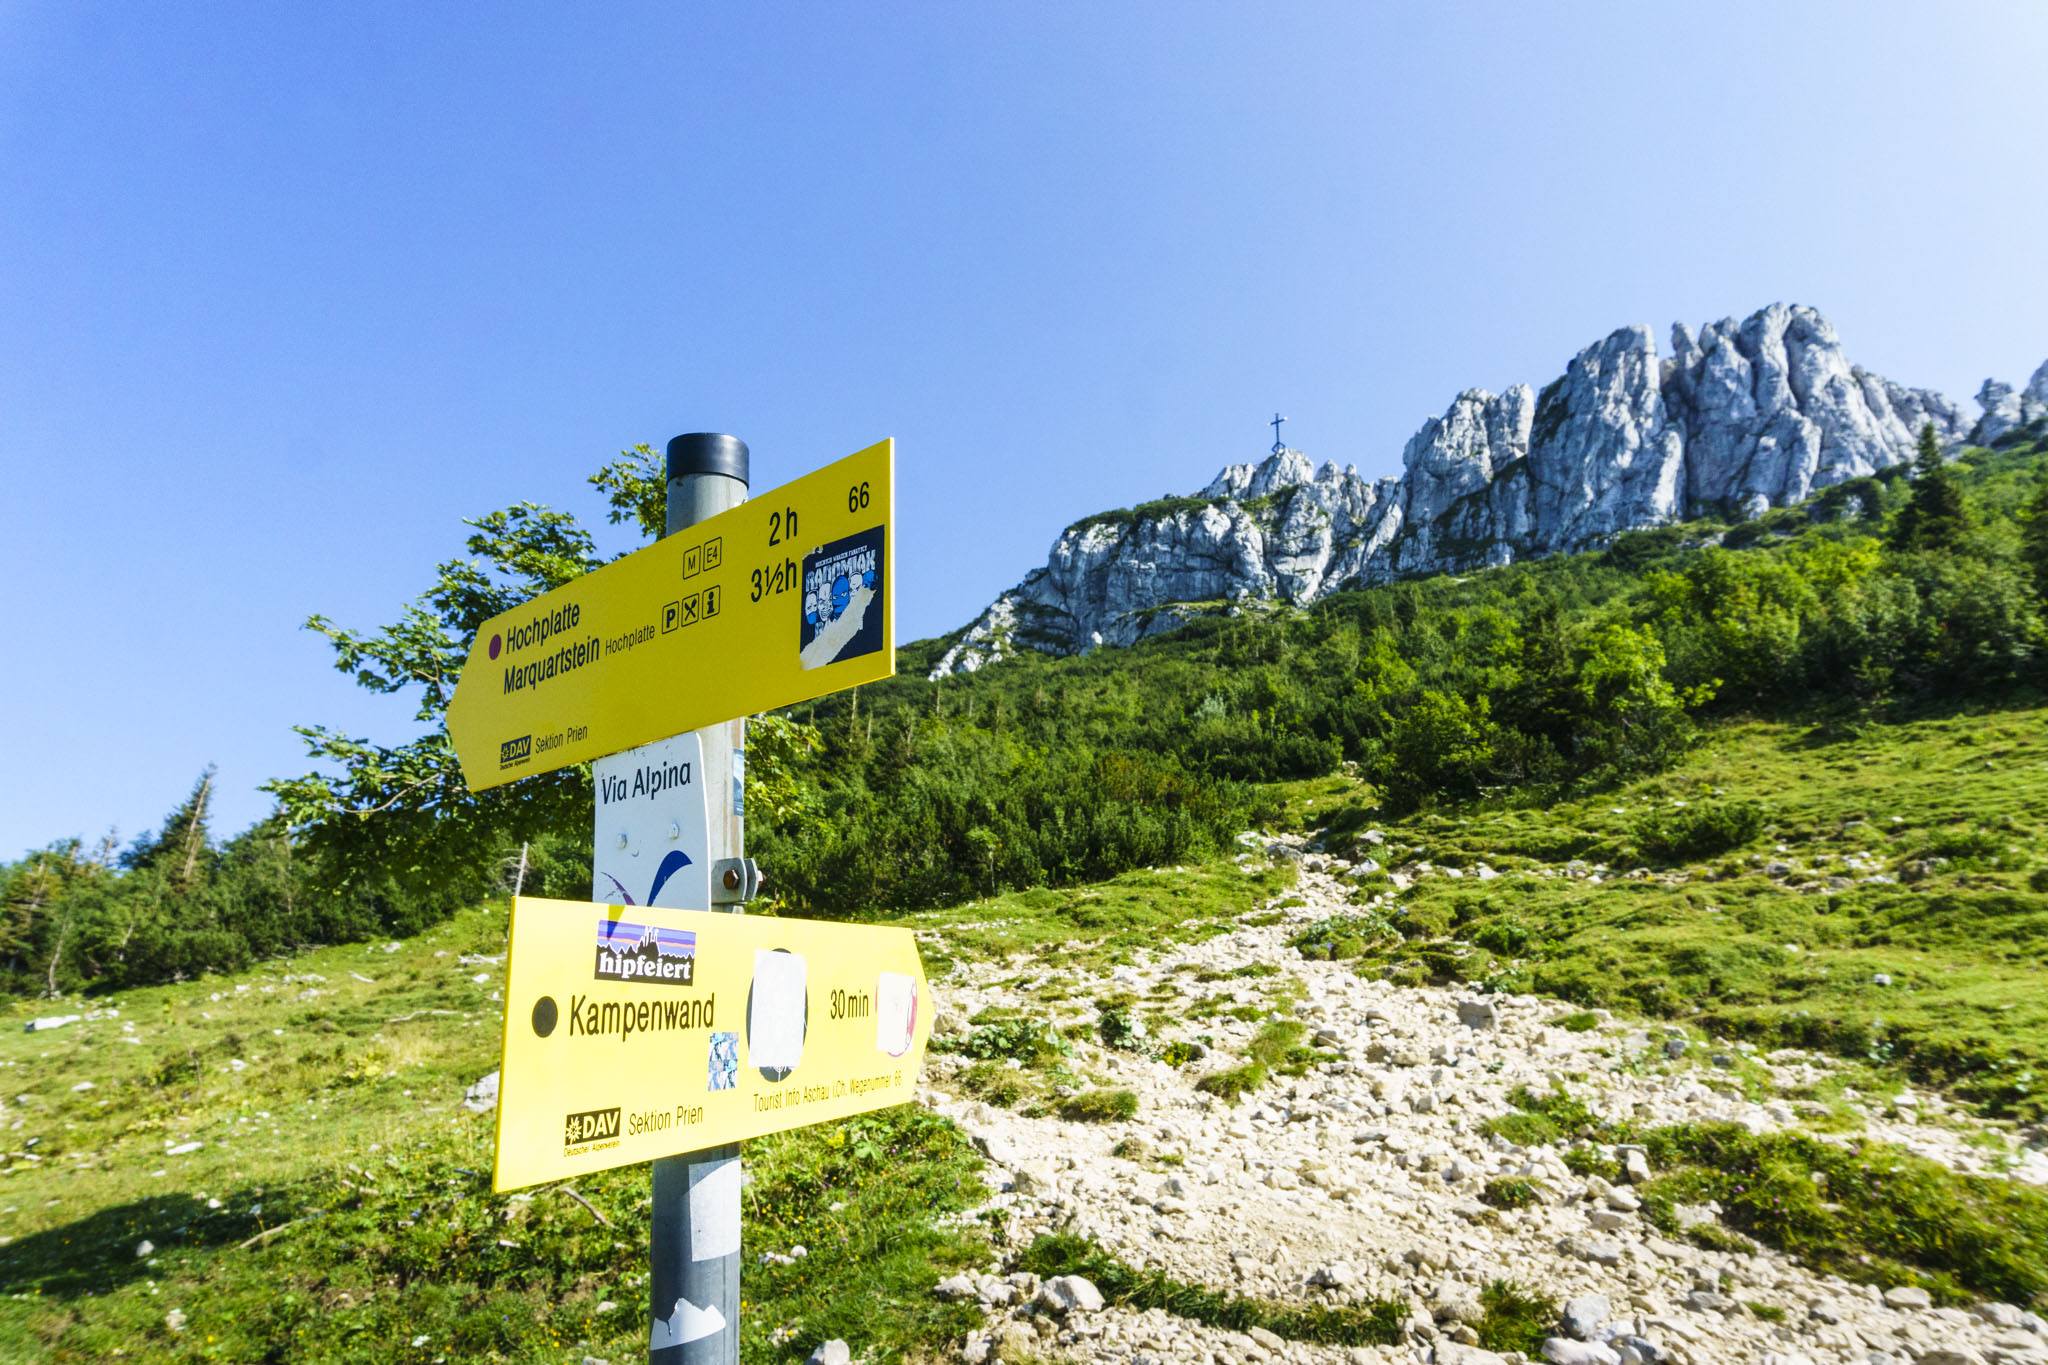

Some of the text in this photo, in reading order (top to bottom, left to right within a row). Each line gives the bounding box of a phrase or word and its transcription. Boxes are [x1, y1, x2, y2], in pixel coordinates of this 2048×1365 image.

[848, 482, 870, 513] 66
[706, 545, 718, 564] E4
[805, 549, 876, 593] RADOMIAK
[506, 602, 580, 654] Hochplatte
[503, 635, 600, 695] Marquartstein
[605, 624, 655, 656] Hochplatte
[509, 725, 588, 758] DAV Sektion Prien
[602, 760, 691, 805] Via Alpina
[598, 951, 691, 980] hipfeiert
[569, 991, 715, 1042] Kampenwand
[753, 1092, 782, 1112] Tourist
[785, 1087, 801, 1107] Info
[803, 1083, 830, 1103] Aschau
[582, 1104, 704, 1140] DAV Sektion Prien
